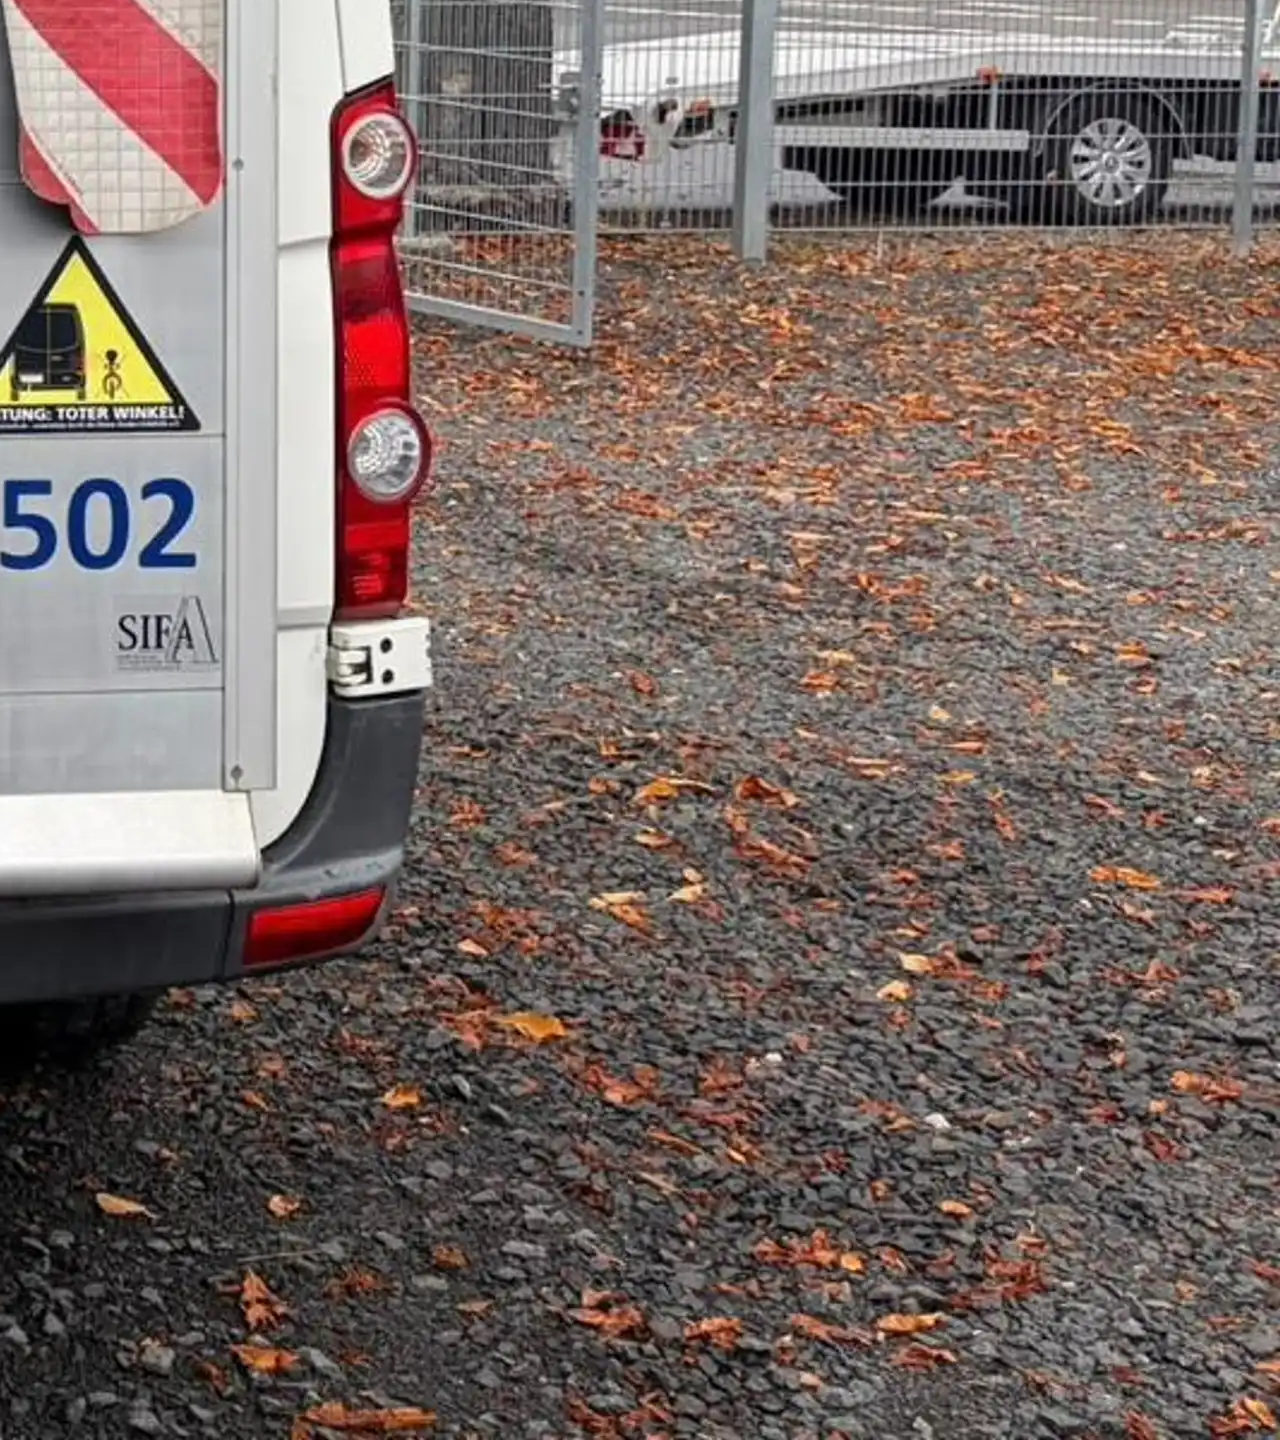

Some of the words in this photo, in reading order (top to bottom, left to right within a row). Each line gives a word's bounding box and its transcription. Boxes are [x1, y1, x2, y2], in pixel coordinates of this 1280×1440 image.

[57, 408, 109, 421] TOTER
[113, 405, 186, 419] WINKEL!
[0, 478, 197, 571] 502
[117, 598, 208, 654] SIFA
